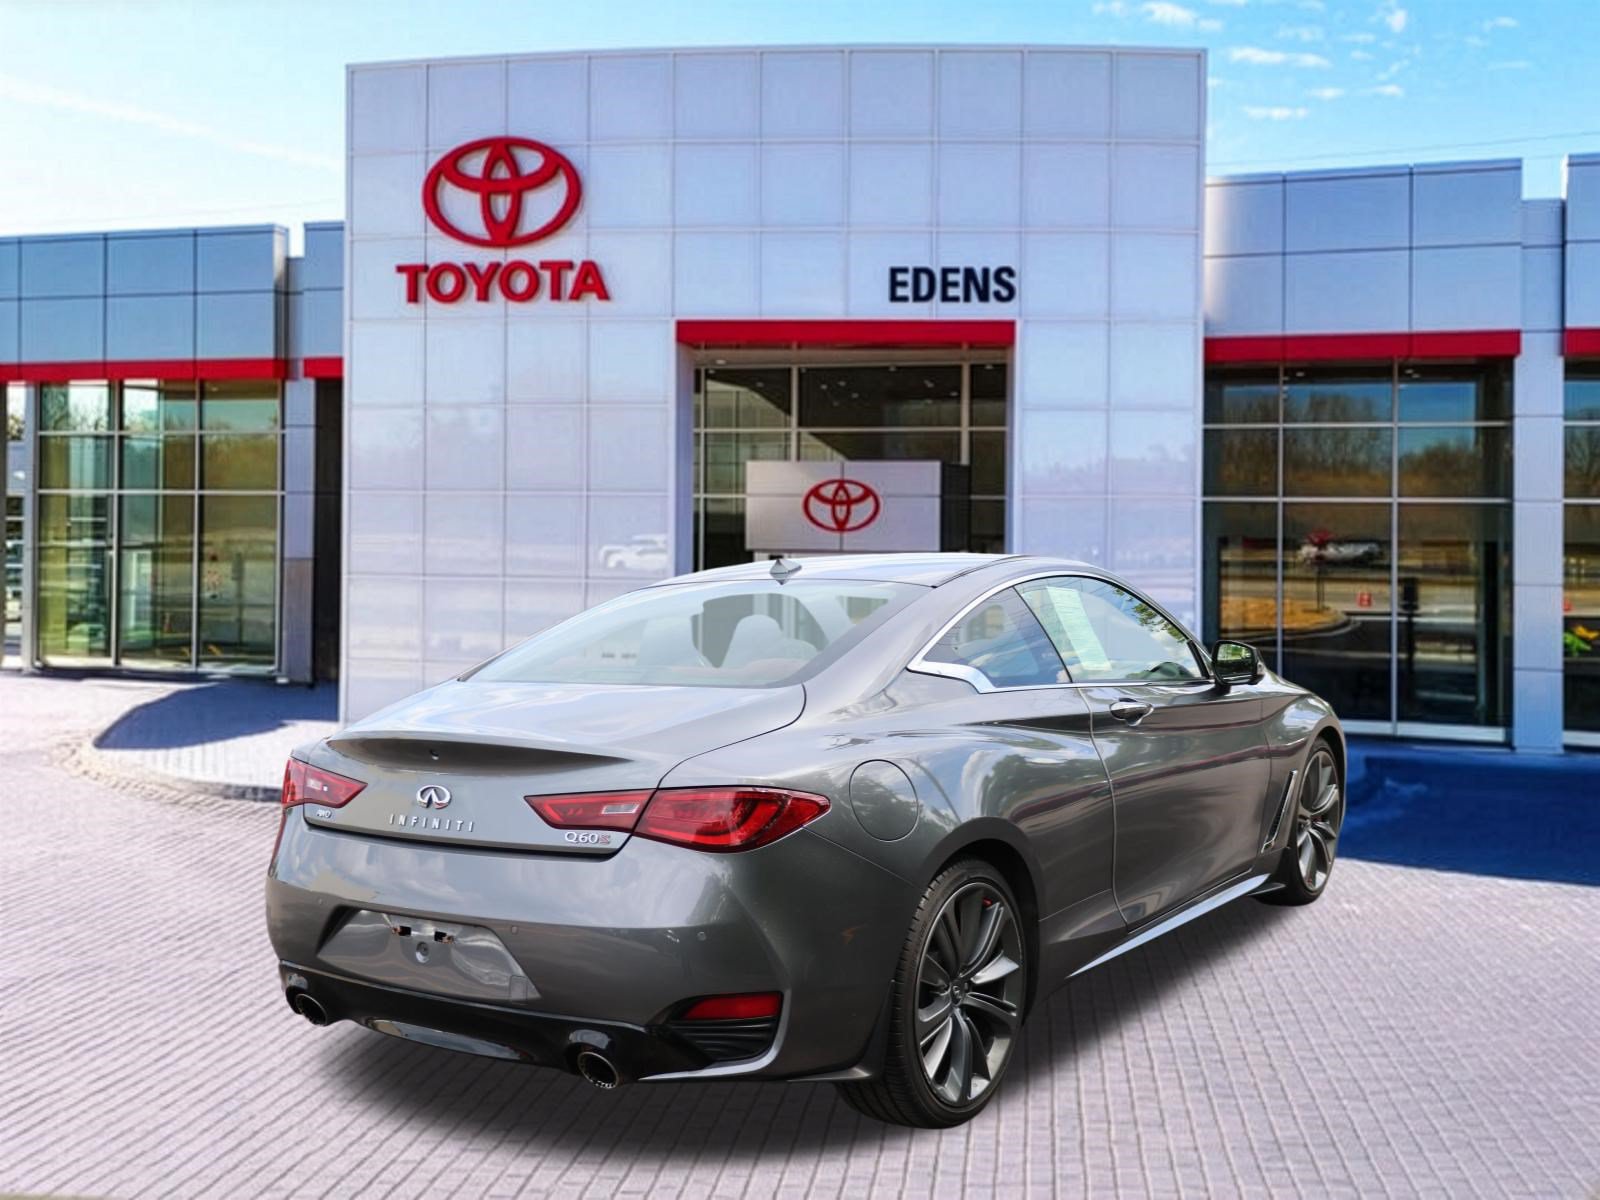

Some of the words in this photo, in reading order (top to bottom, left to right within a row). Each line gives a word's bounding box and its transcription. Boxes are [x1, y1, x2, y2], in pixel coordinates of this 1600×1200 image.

[395, 260, 611, 304] TOYOTA
[889, 266, 1016, 303] EDENS
[389, 813, 475, 832] INFINITI
